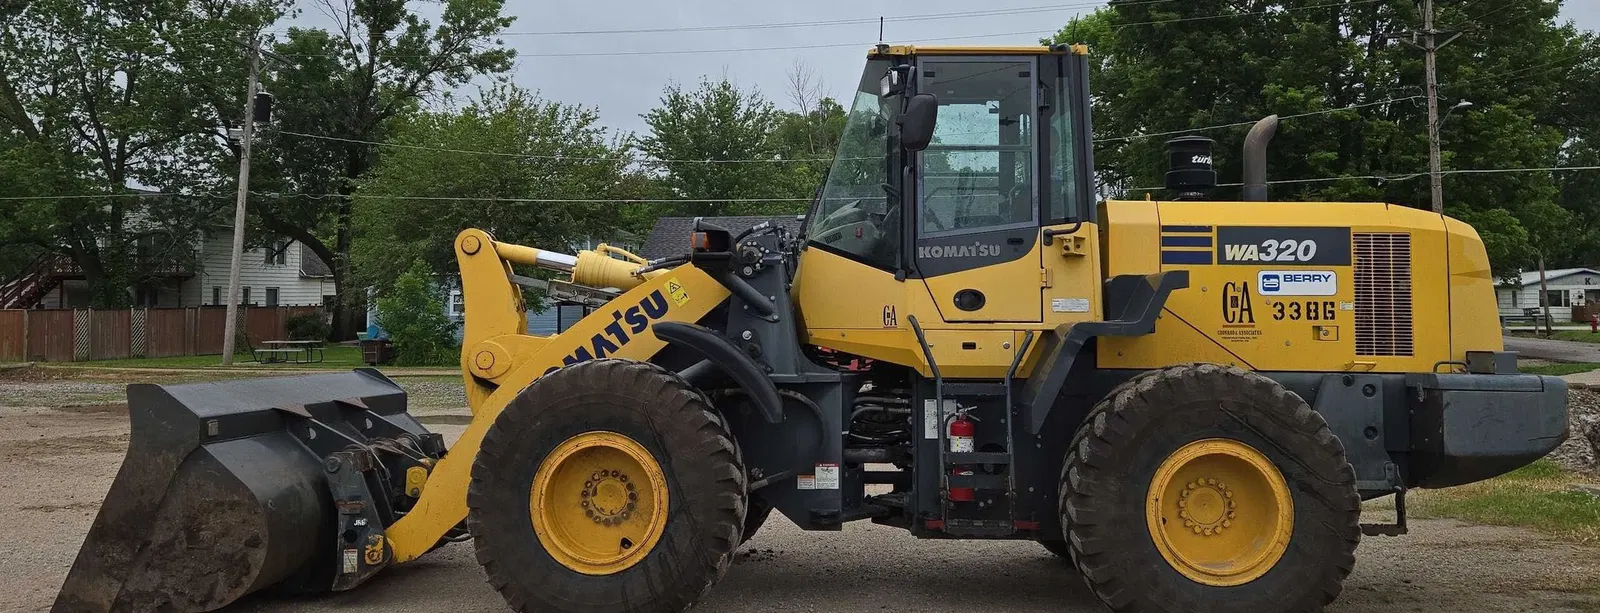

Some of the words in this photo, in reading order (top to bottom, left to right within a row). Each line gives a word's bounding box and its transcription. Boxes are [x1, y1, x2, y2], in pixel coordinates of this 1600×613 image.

[918, 241, 1001, 258] KOMATSU
[1224, 239, 1317, 262] WA320
[1283, 274, 1332, 283] BERRY
[534, 289, 669, 381] MATSU
